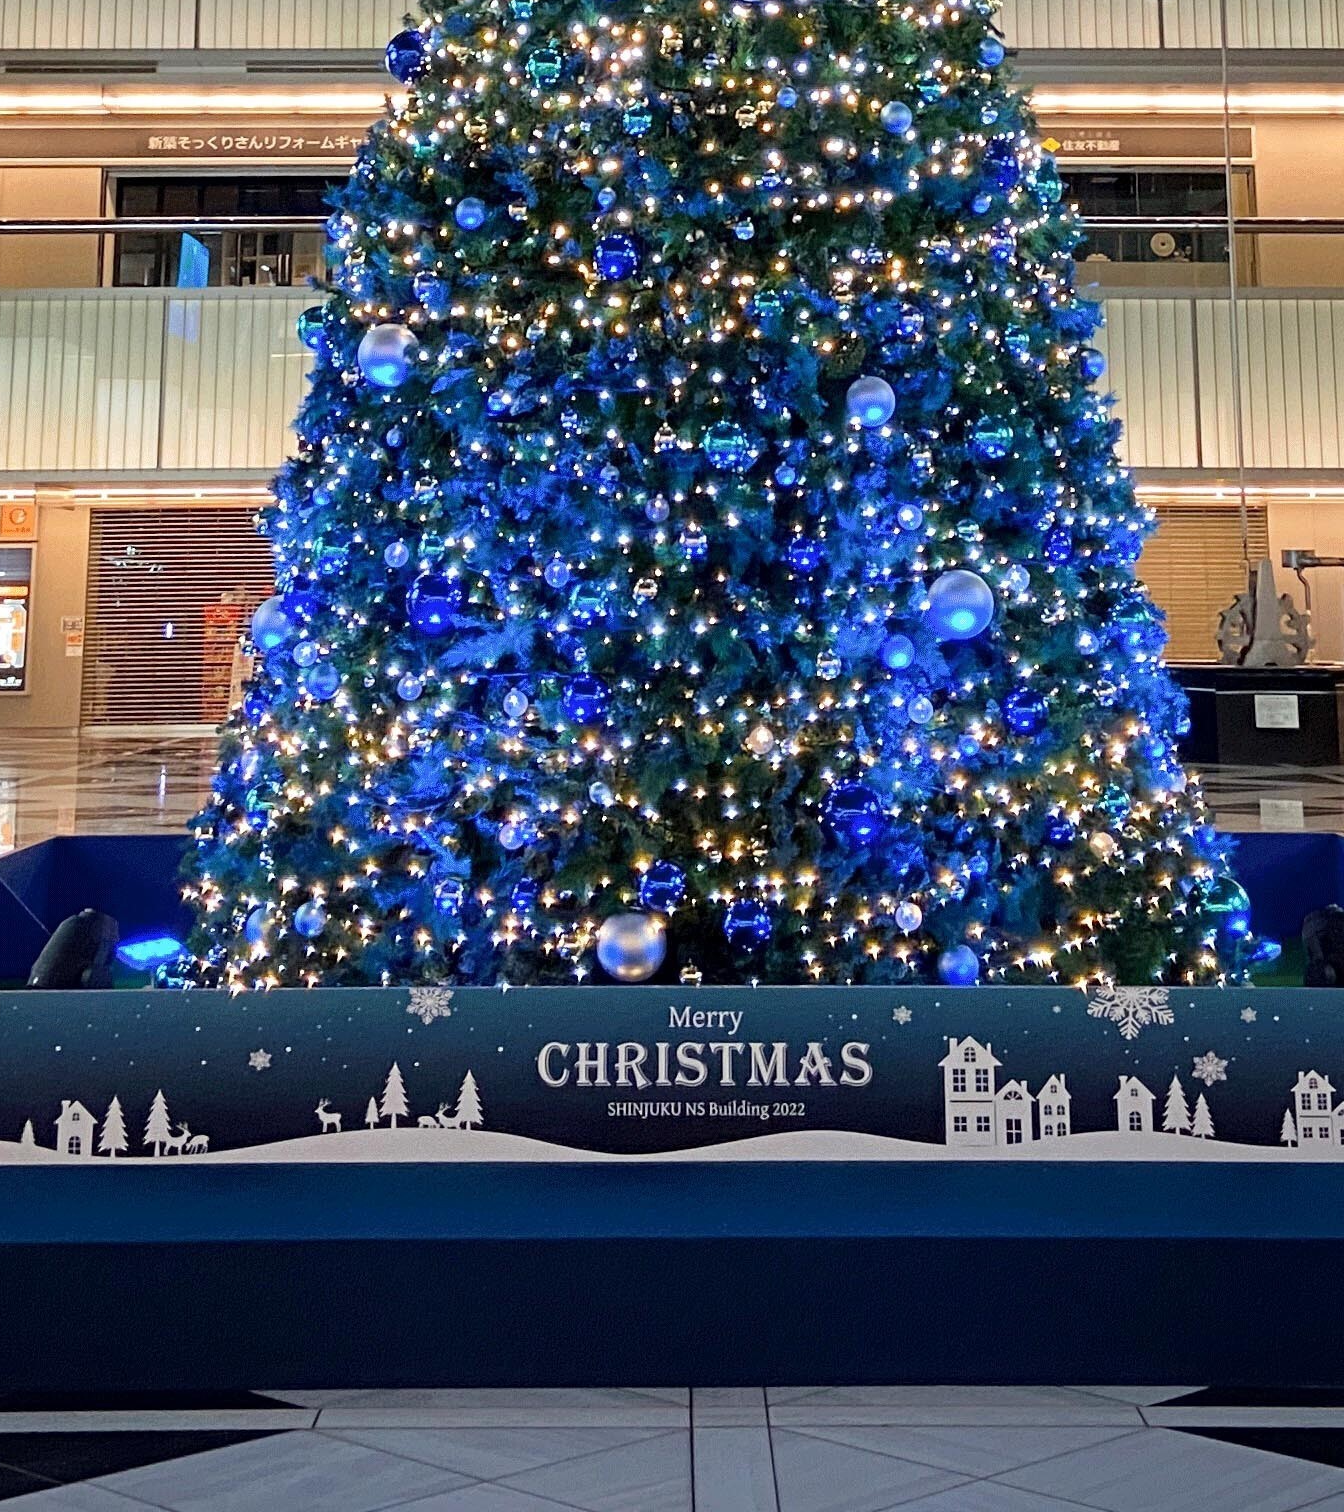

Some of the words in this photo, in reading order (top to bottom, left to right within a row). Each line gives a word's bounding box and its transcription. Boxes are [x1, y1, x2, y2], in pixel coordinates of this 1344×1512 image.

[668, 1006, 743, 1035] Merry
[537, 1041, 873, 1090] CHRISTMAS
[607, 1102, 682, 1119] SHINJUKU
[685, 1102, 705, 1117] NS
[709, 1102, 770, 1120] Building
[772, 1102, 805, 1117] 2022
